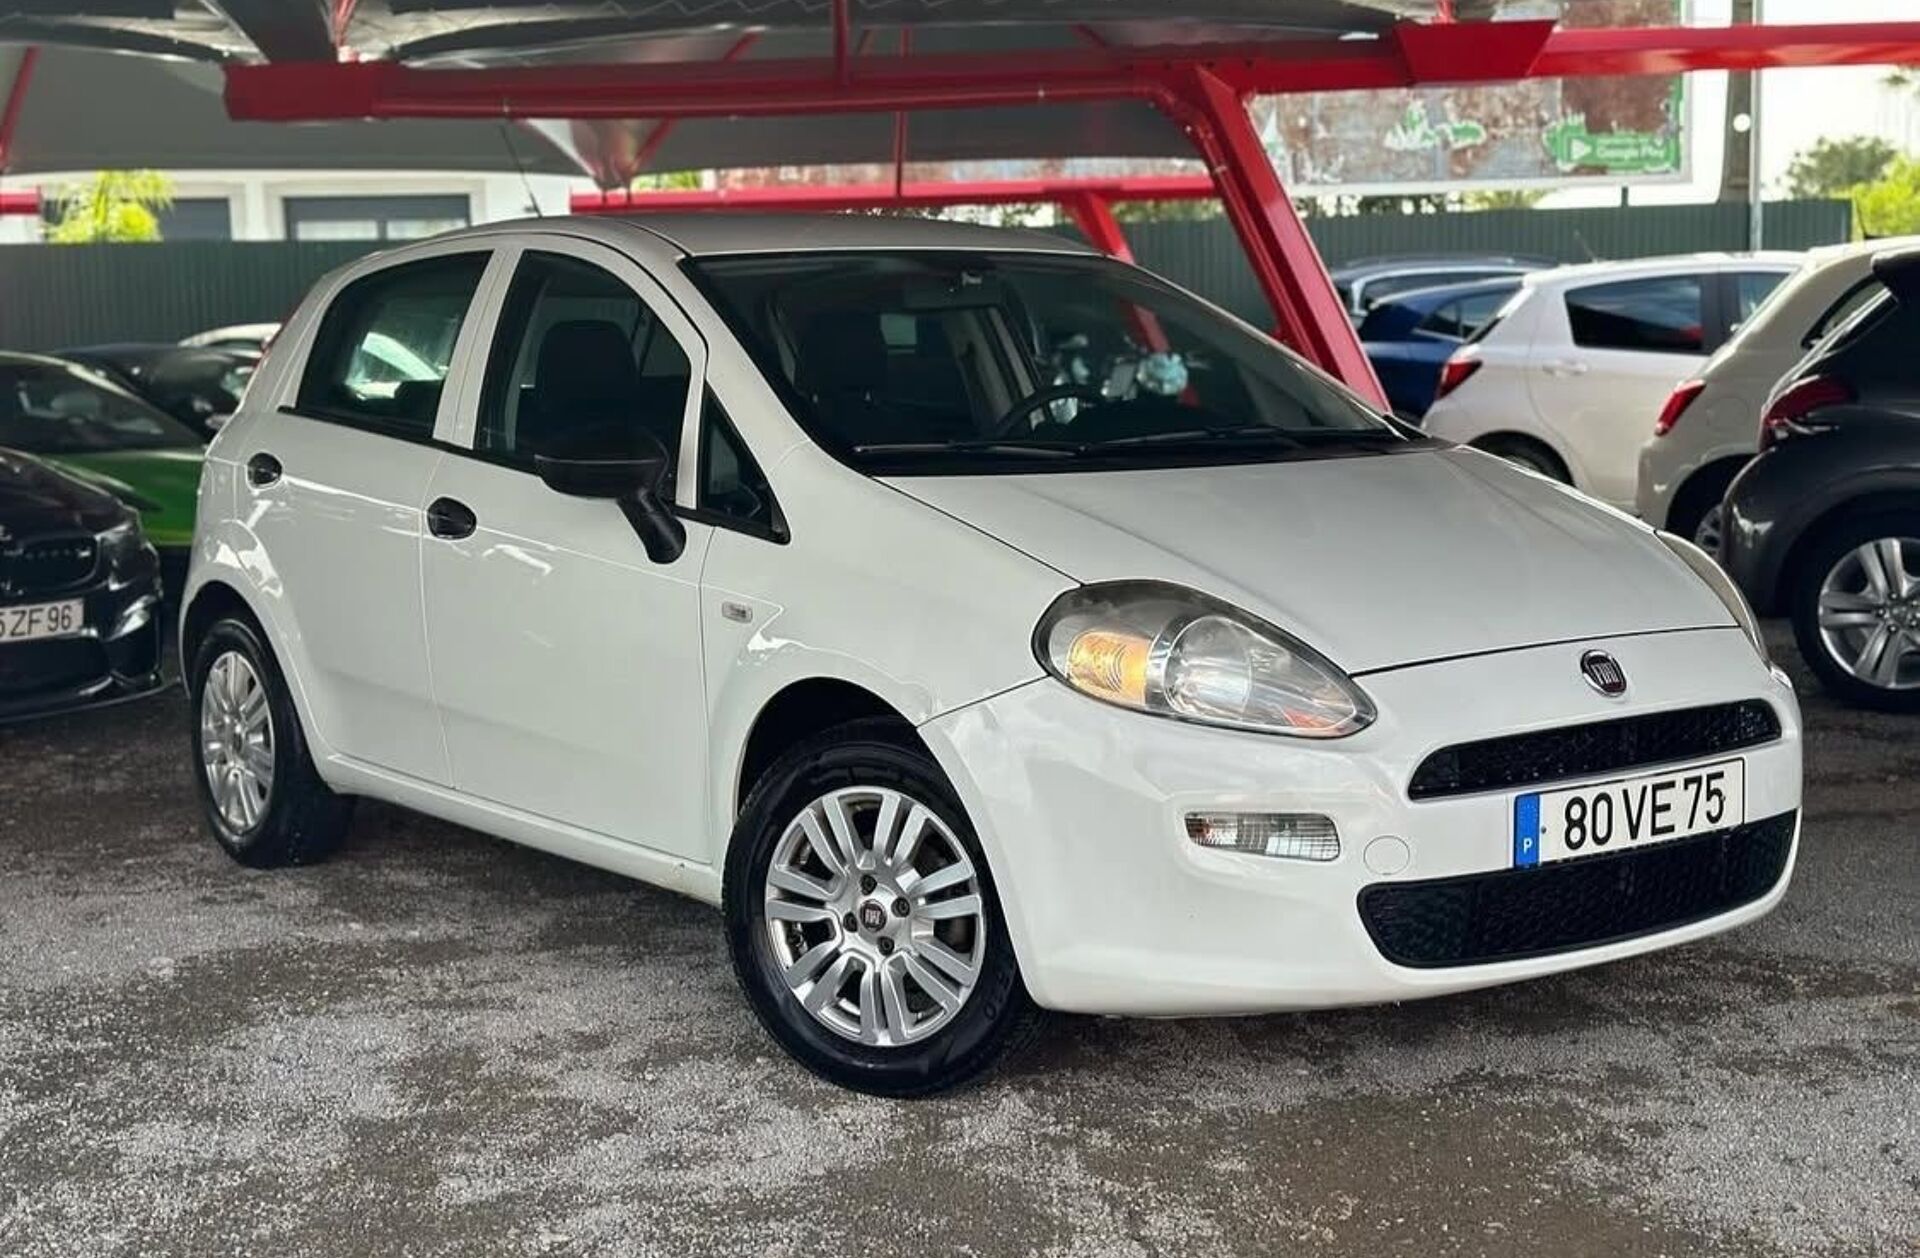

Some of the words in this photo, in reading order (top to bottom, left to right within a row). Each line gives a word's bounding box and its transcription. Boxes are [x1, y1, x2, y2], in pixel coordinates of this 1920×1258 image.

[10, 608, 44, 637] ZF
[48, 604, 72, 632] 96
[1564, 792, 1613, 850] 80
[1622, 780, 1676, 841] VE
[1684, 771, 1725, 829] 75
[1523, 838, 1533, 854] P
